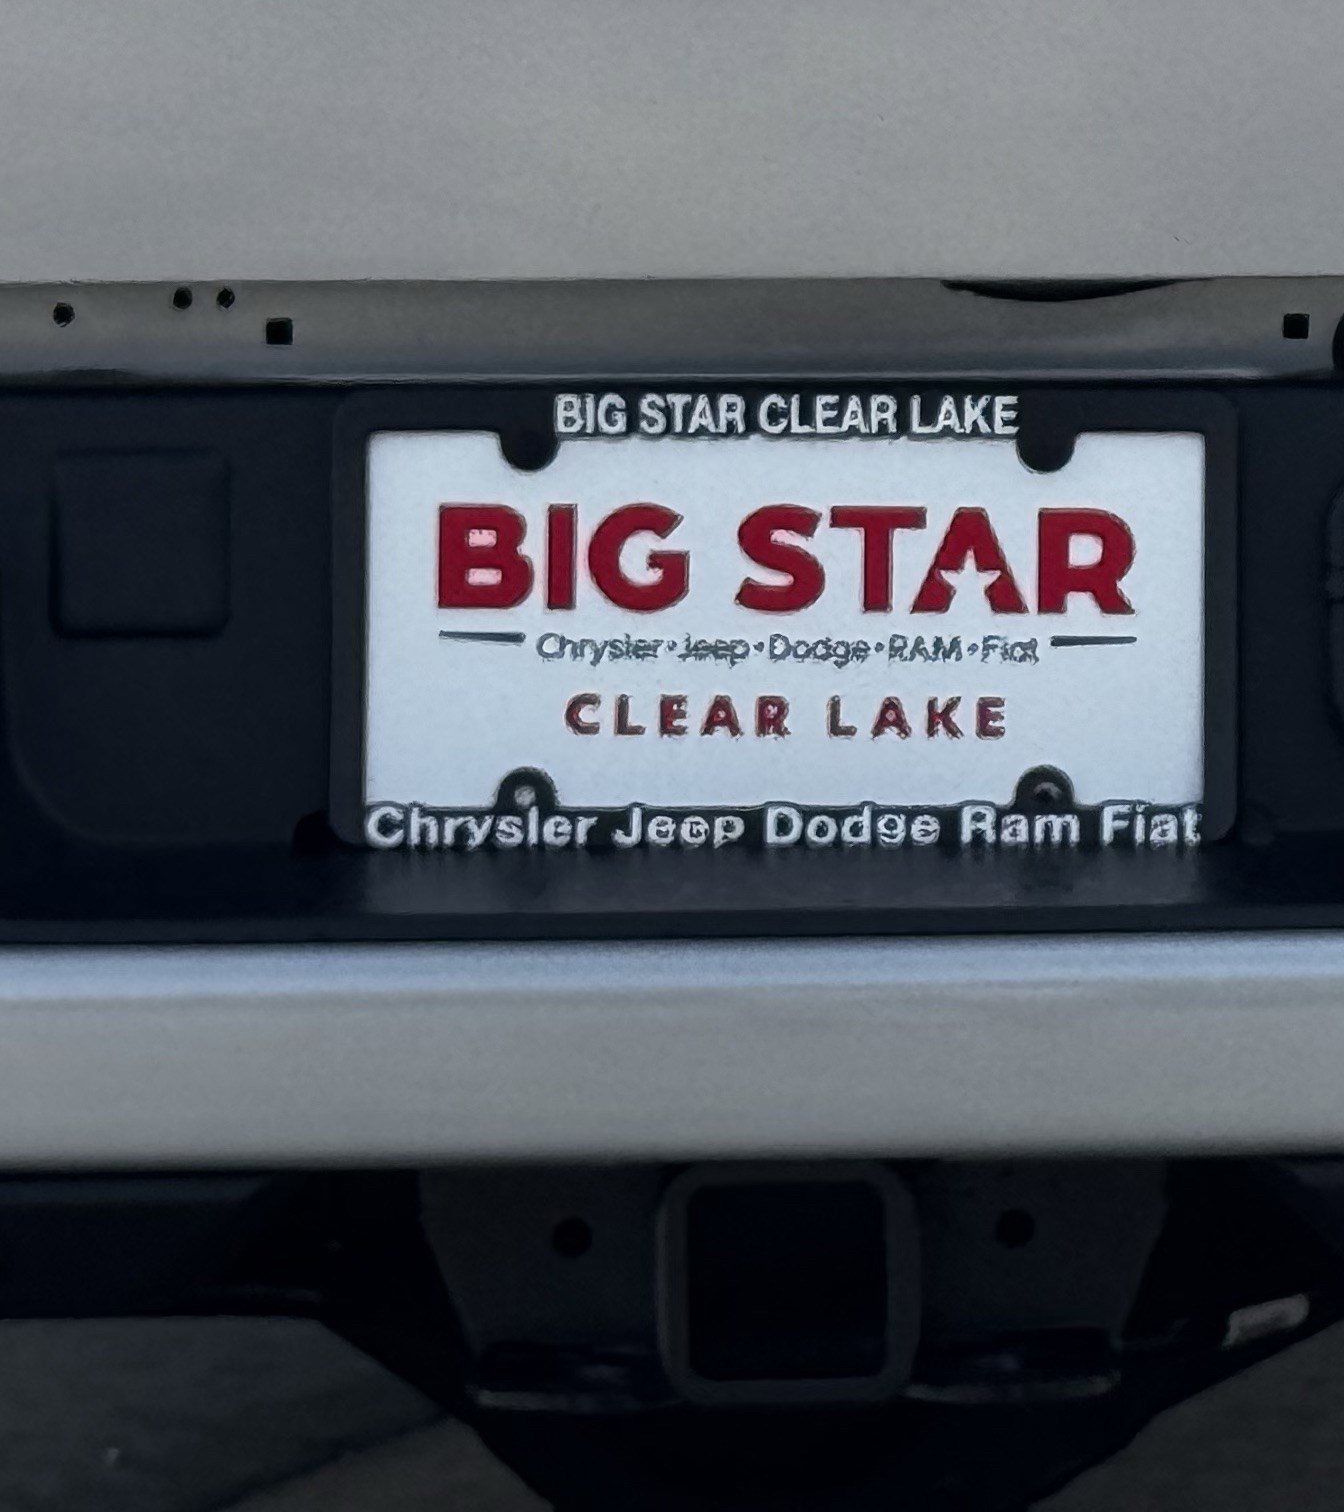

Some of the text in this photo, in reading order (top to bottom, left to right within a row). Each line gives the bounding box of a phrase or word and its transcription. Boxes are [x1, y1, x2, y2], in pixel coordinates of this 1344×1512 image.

[552, 393, 1020, 437] BIG STAR CLEAR LAKE
[436, 502, 1137, 616] BIG STAR
[564, 693, 1008, 740] CLEAR LAKE
[365, 804, 1201, 849] Chrysler Jeep Dodge Ram Fiat
